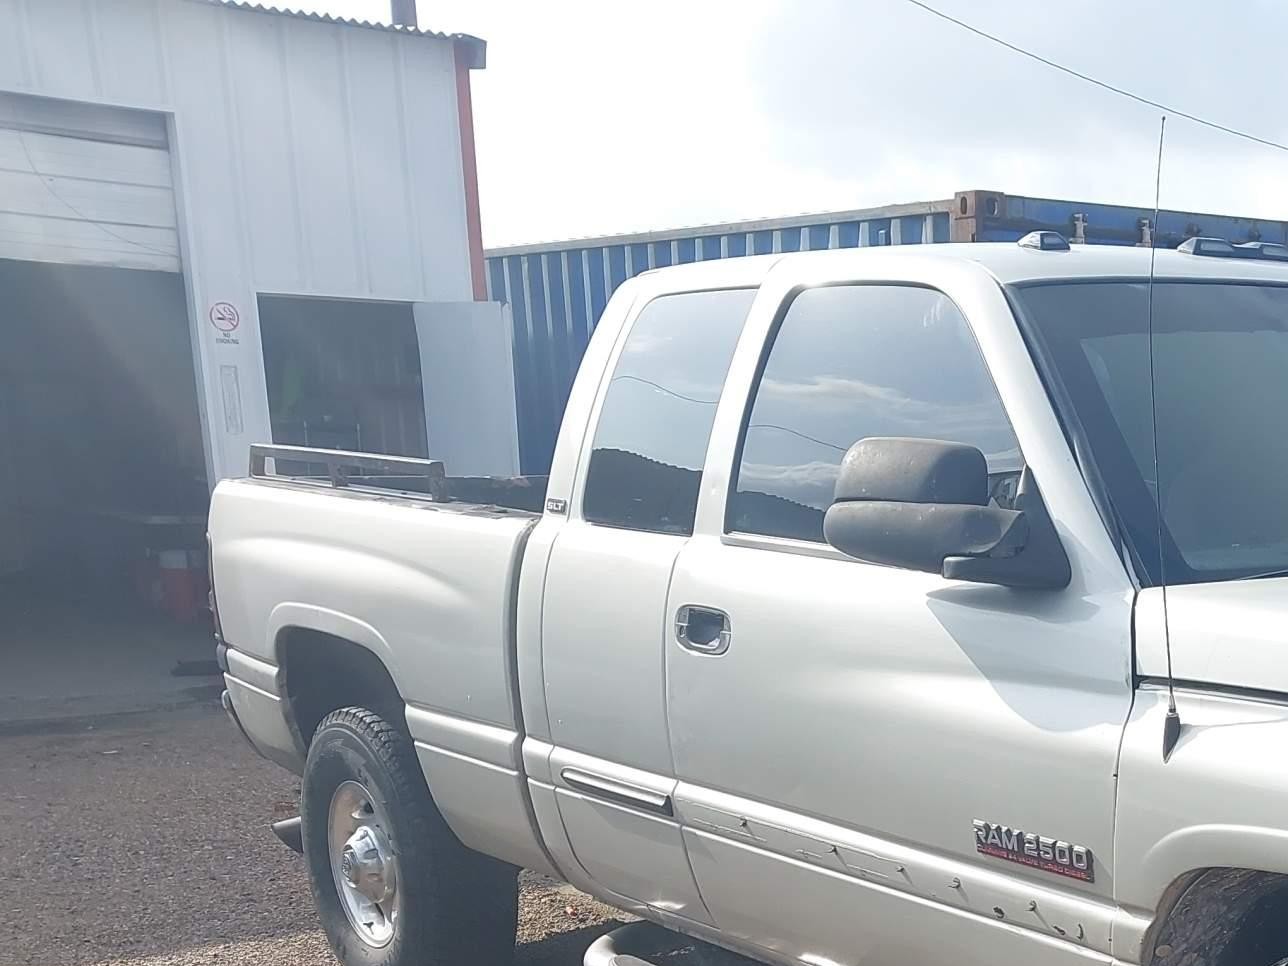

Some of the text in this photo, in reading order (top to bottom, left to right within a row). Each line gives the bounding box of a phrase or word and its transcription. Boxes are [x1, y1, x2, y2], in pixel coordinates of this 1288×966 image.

[547, 501, 565, 511] SLT
[973, 819, 1088, 869] RAM 2500
